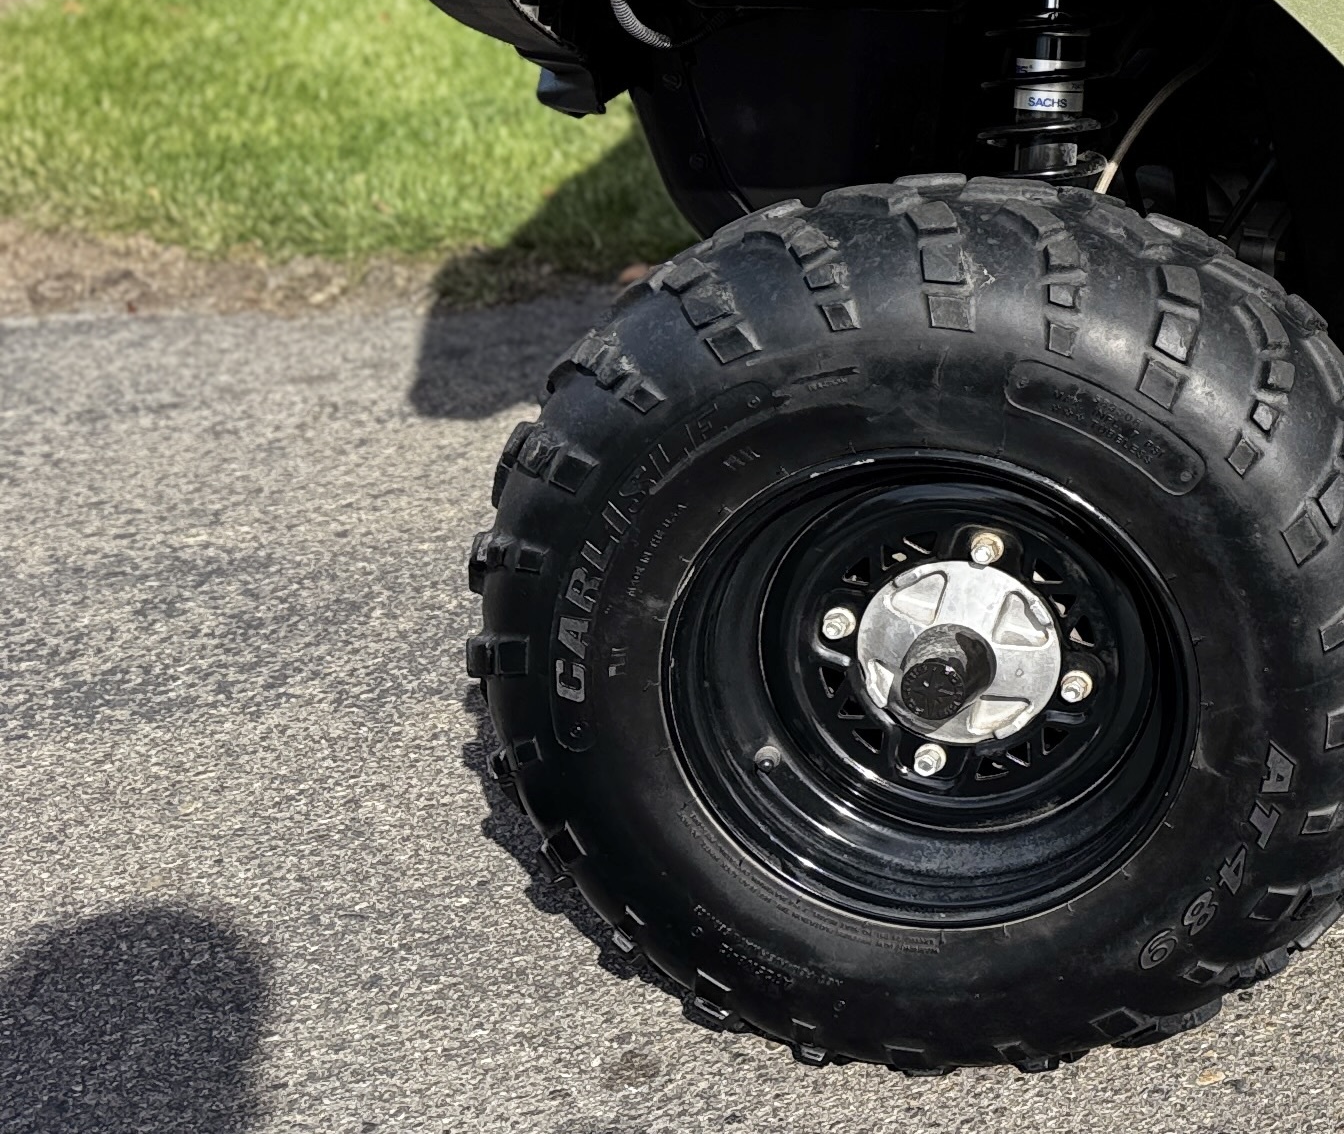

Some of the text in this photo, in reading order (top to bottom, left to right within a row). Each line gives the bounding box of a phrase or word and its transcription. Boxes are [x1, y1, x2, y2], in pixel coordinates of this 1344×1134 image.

[1027, 97, 1067, 109] SACHS
[552, 402, 727, 702] CARLISLE
[1137, 741, 1298, 973] AT489
